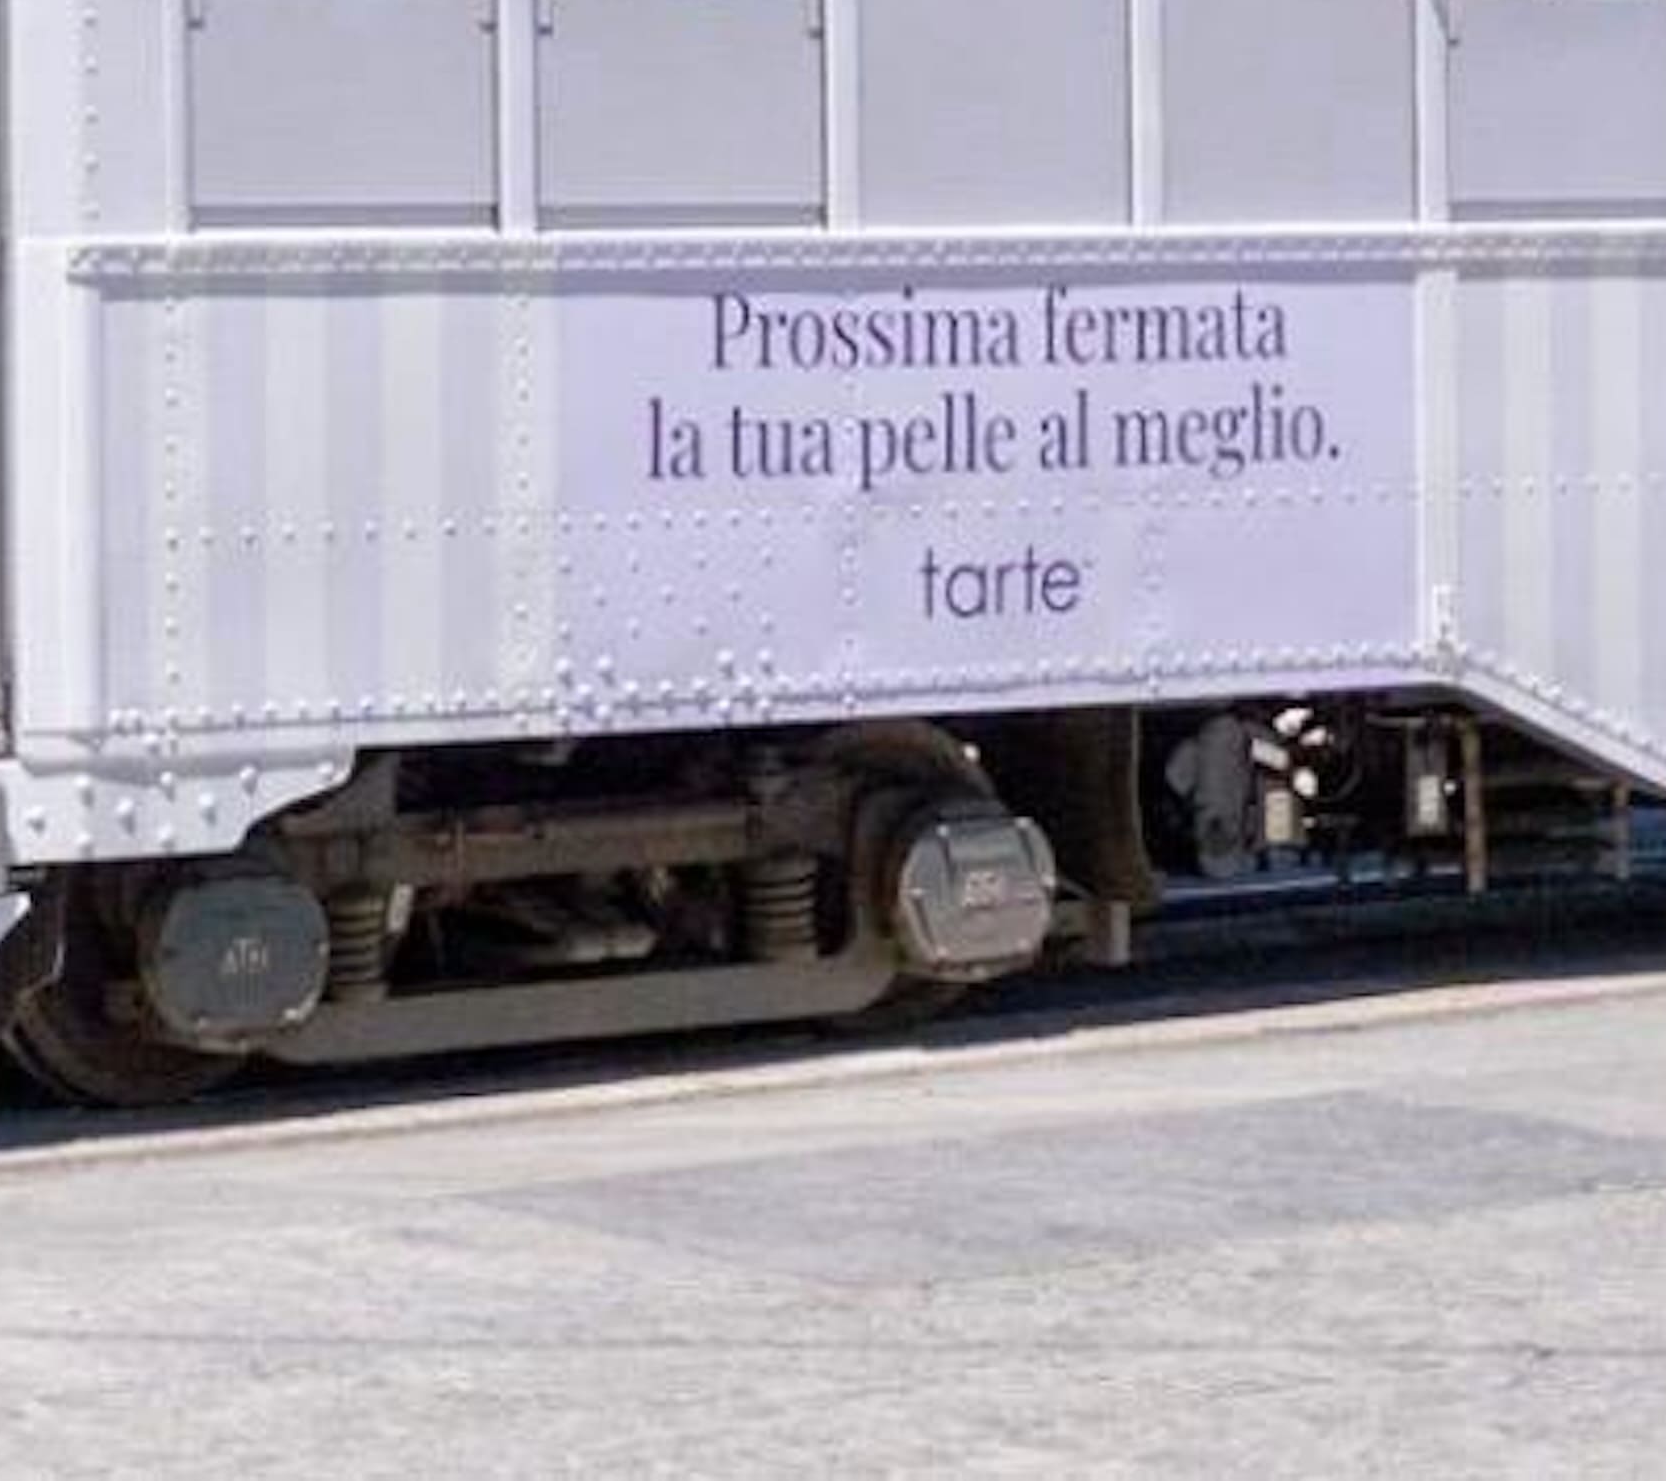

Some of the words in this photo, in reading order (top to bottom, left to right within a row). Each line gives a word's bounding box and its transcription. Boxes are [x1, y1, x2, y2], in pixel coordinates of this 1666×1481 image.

[710, 287, 1022, 371] Prossima
[1043, 286, 1287, 364] fermata
[646, 396, 703, 480] la
[729, 401, 836, 479] tua
[856, 389, 1016, 491] pelle
[1039, 388, 1091, 471] al
[1113, 383, 1341, 482] meglio.
[919, 545, 1083, 619] tarte
